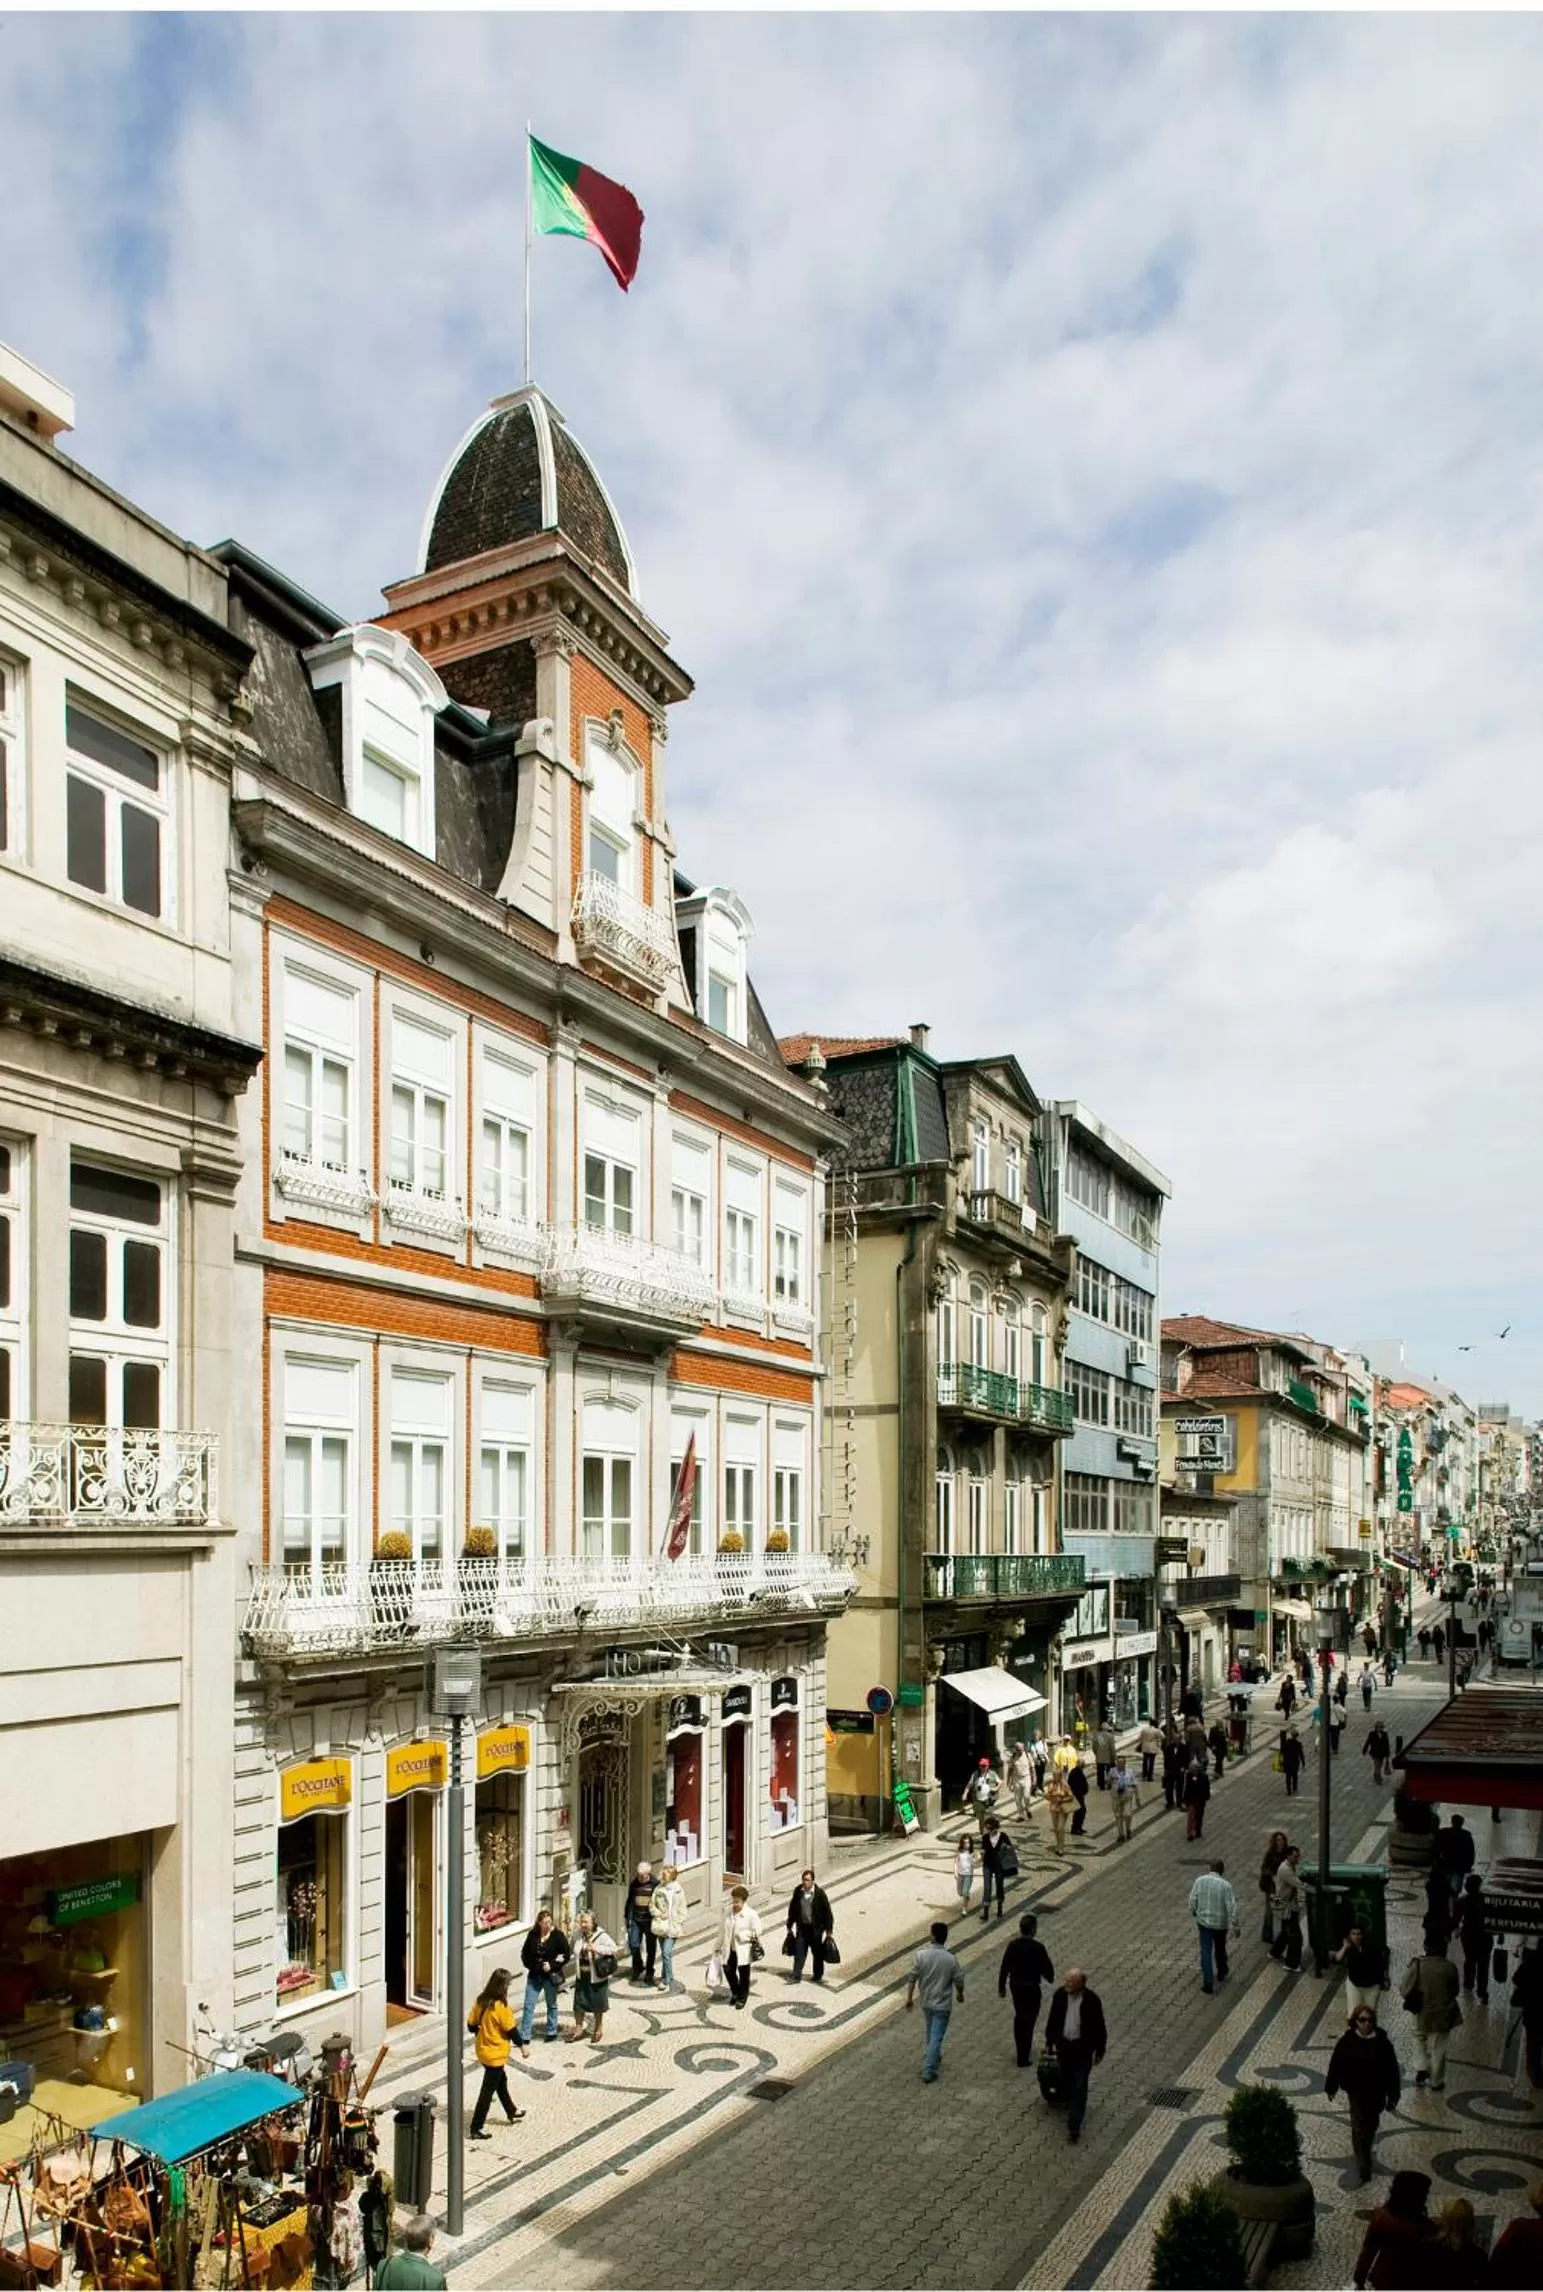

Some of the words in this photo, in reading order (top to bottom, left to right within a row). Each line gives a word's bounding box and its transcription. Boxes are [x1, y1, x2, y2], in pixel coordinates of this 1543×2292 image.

[58, 1887, 89, 1902] UNITED
[89, 1879, 122, 1894] COLORS
[58, 1902, 70, 1912] OF
[71, 1892, 113, 1910] BENETTON
